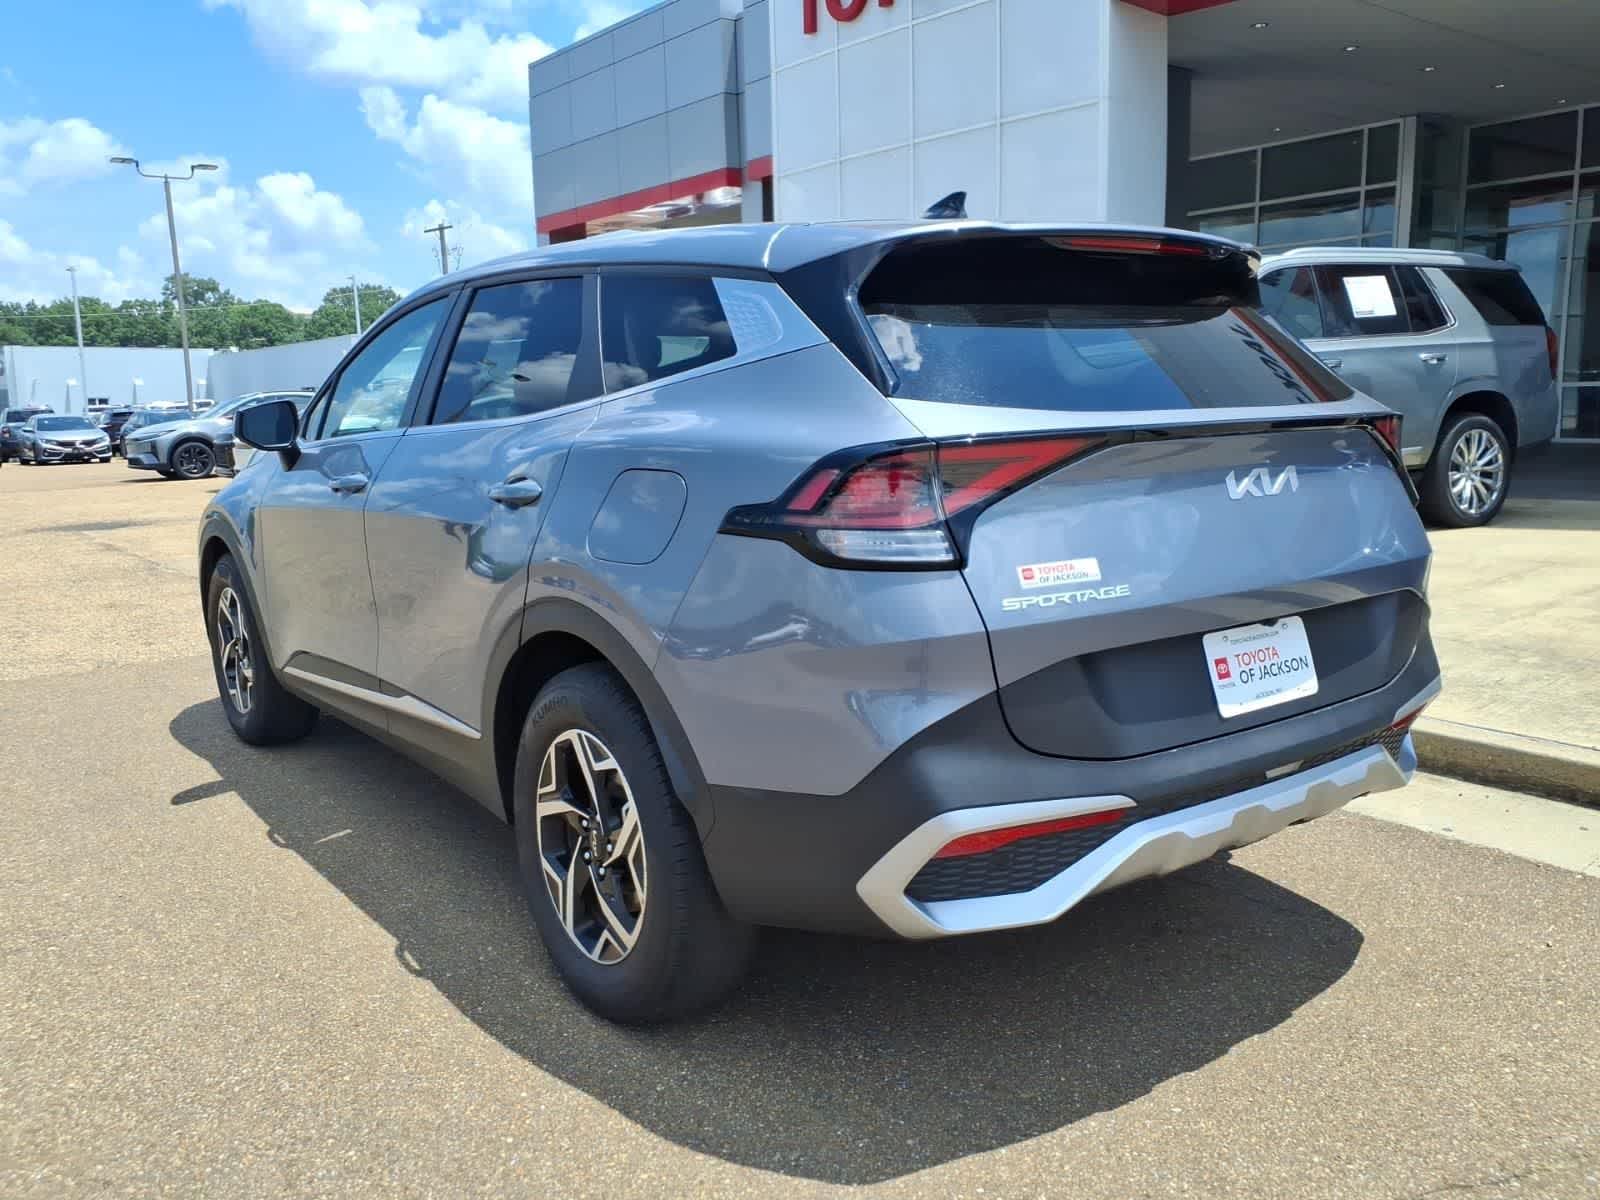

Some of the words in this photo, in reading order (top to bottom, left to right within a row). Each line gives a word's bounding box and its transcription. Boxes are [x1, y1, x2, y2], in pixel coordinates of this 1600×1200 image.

[1225, 465, 1299, 500] KIA
[1038, 563, 1076, 575] TOYOTA
[1039, 576, 1050, 584] OF
[1053, 571, 1089, 583] JACKSON
[1002, 584, 1131, 610] SPORTAGE
[1234, 646, 1280, 668] TOYOTA
[1240, 667, 1256, 684] OF
[1259, 655, 1309, 680] JACKSON
